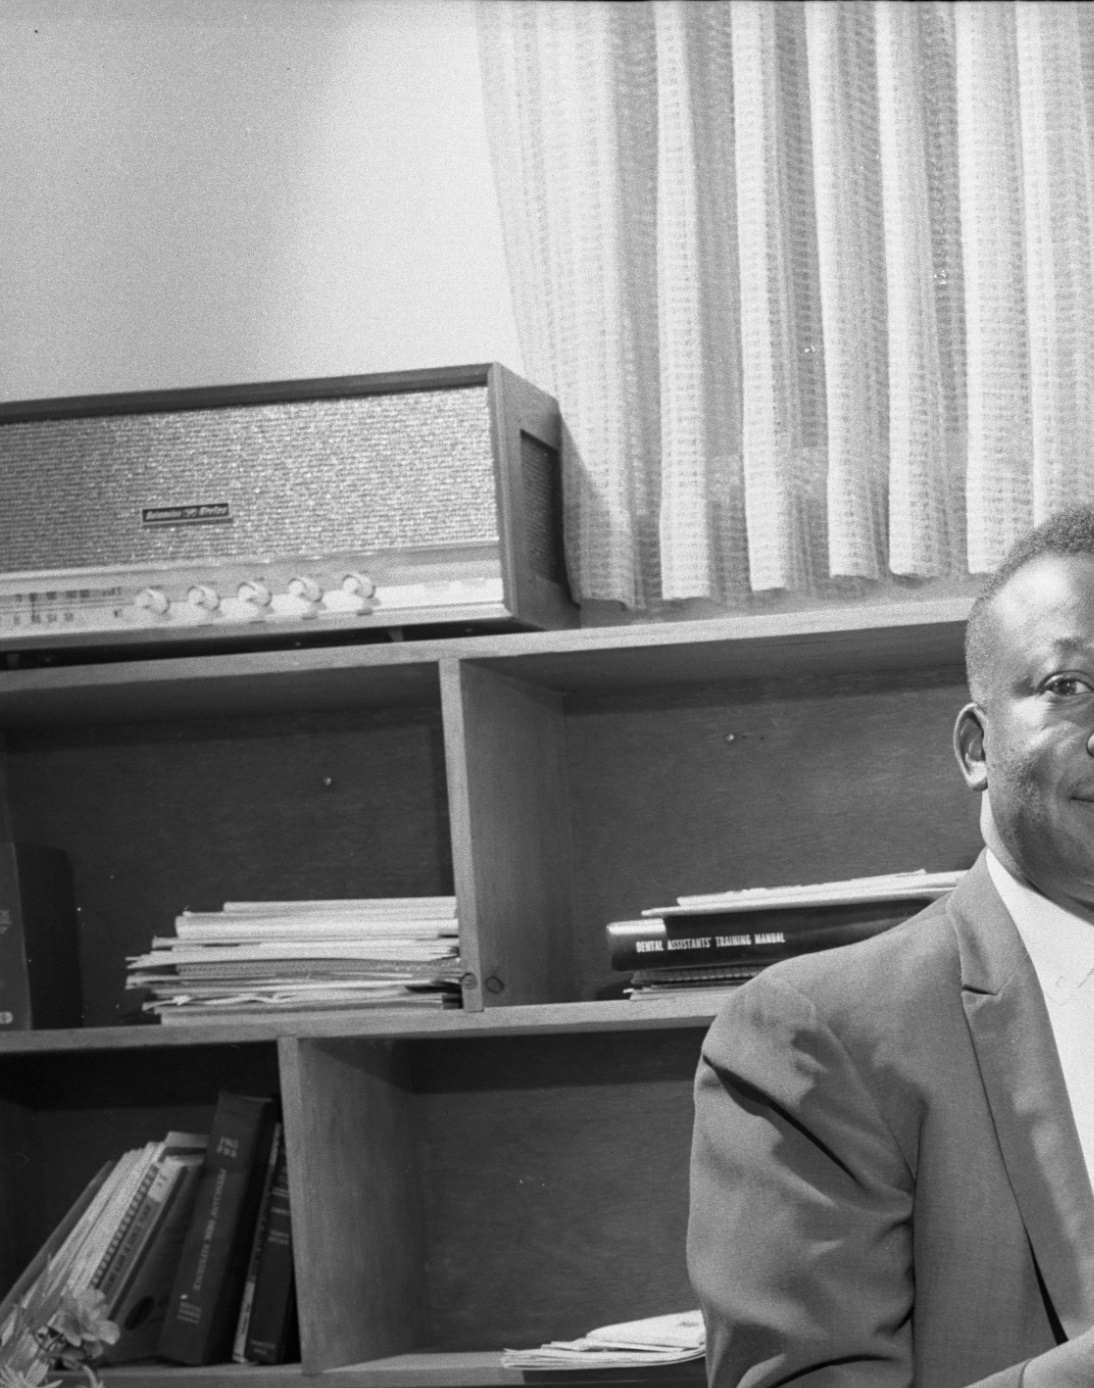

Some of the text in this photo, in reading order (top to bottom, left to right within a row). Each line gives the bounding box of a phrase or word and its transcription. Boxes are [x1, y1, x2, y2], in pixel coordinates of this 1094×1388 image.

[635, 940, 664, 953] DENTAL
[715, 934, 752, 947] TRAINING
[754, 932, 786, 944] MANUAL
